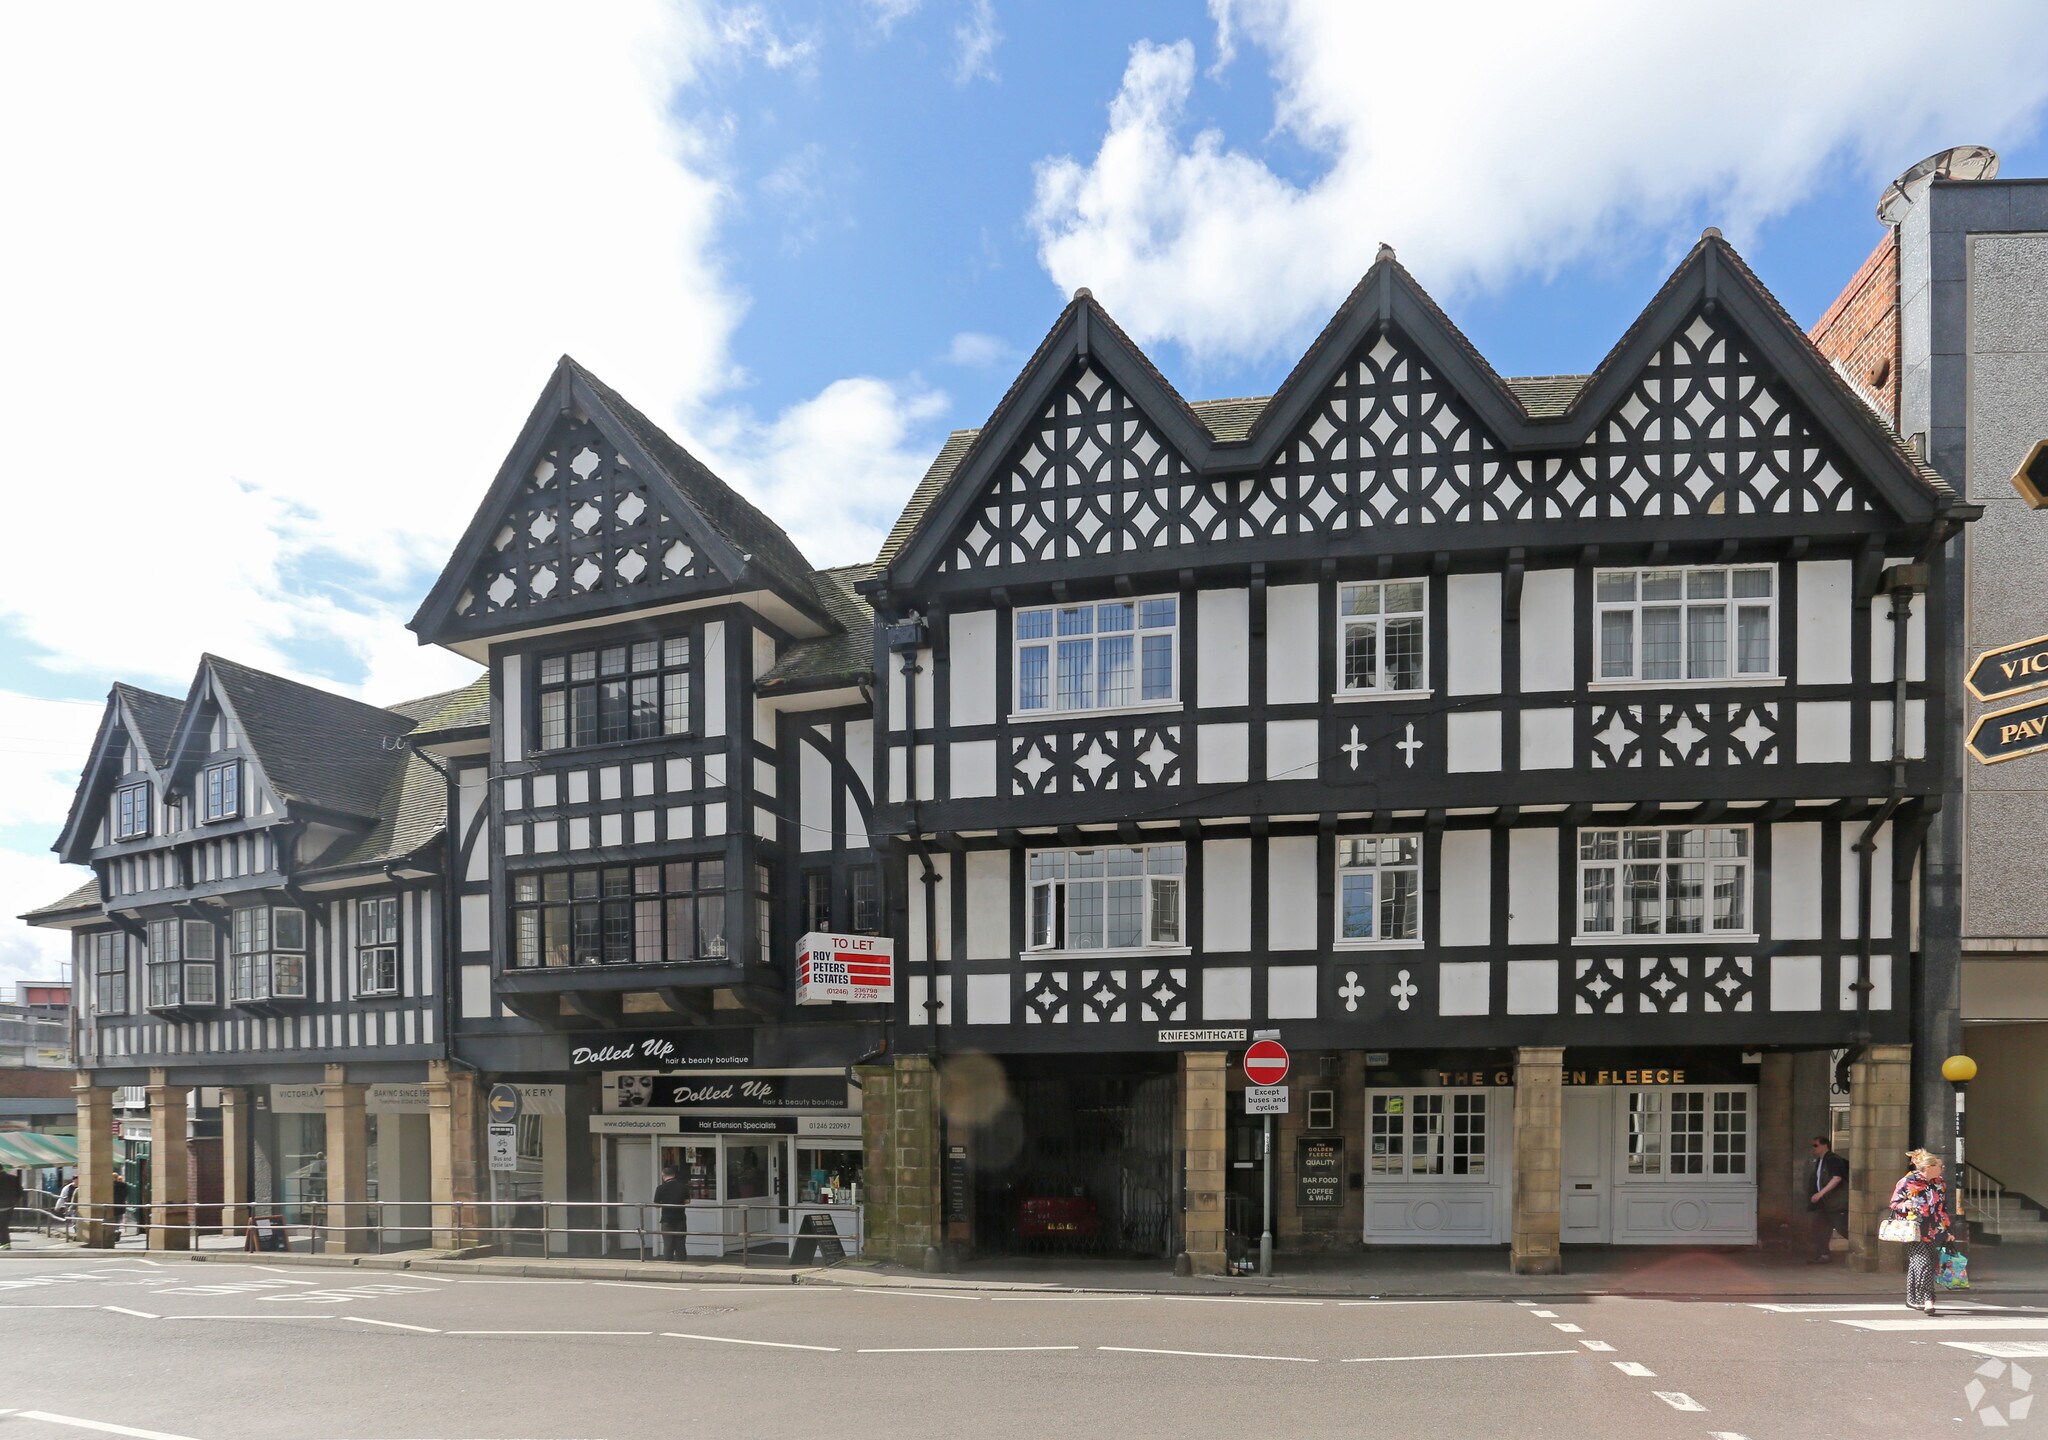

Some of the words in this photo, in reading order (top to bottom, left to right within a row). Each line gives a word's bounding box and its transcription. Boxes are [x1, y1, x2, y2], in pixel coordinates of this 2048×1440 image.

[2000, 715, 2048, 744] PAV
[832, 938, 848, 949] TO
[853, 940, 874, 950] LET
[813, 951, 830, 961] ROY
[813, 962, 845, 973] PETERS
[813, 973, 849, 984] ESTATES
[827, 987, 848, 995] (01246)
[1160, 1030, 1245, 1041] KNIFESMITHGATE
[572, 1043, 634, 1064] Dolled
[641, 1038, 675, 1059] Up
[688, 1056, 713, 1065] beauty
[716, 1056, 749, 1064] boutique
[1440, 1072, 1483, 1085] THE
[1494, 1071, 1586, 1085] GEN
[1597, 1070, 1685, 1084] FLEECE
[279, 1090, 314, 1098] VICTORIA
[373, 1089, 397, 1098] BAKING
[399, 1089, 418, 1098] SINCE
[419, 1089, 430, 1098] 199
[517, 1088, 553, 1097] AKERY
[672, 1084, 733, 1103] Dolled
[740, 1080, 773, 1100] Up
[811, 1098, 844, 1106] boutique
[604, 1120, 666, 1128] www.dolledupuk.com
[699, 1121, 711, 1129] Hair
[712, 1121, 742, 1129] Extension
[743, 1121, 776, 1130] Specialists
[809, 1122, 827, 1130] 01246
[828, 1122, 851, 1130] 220987
